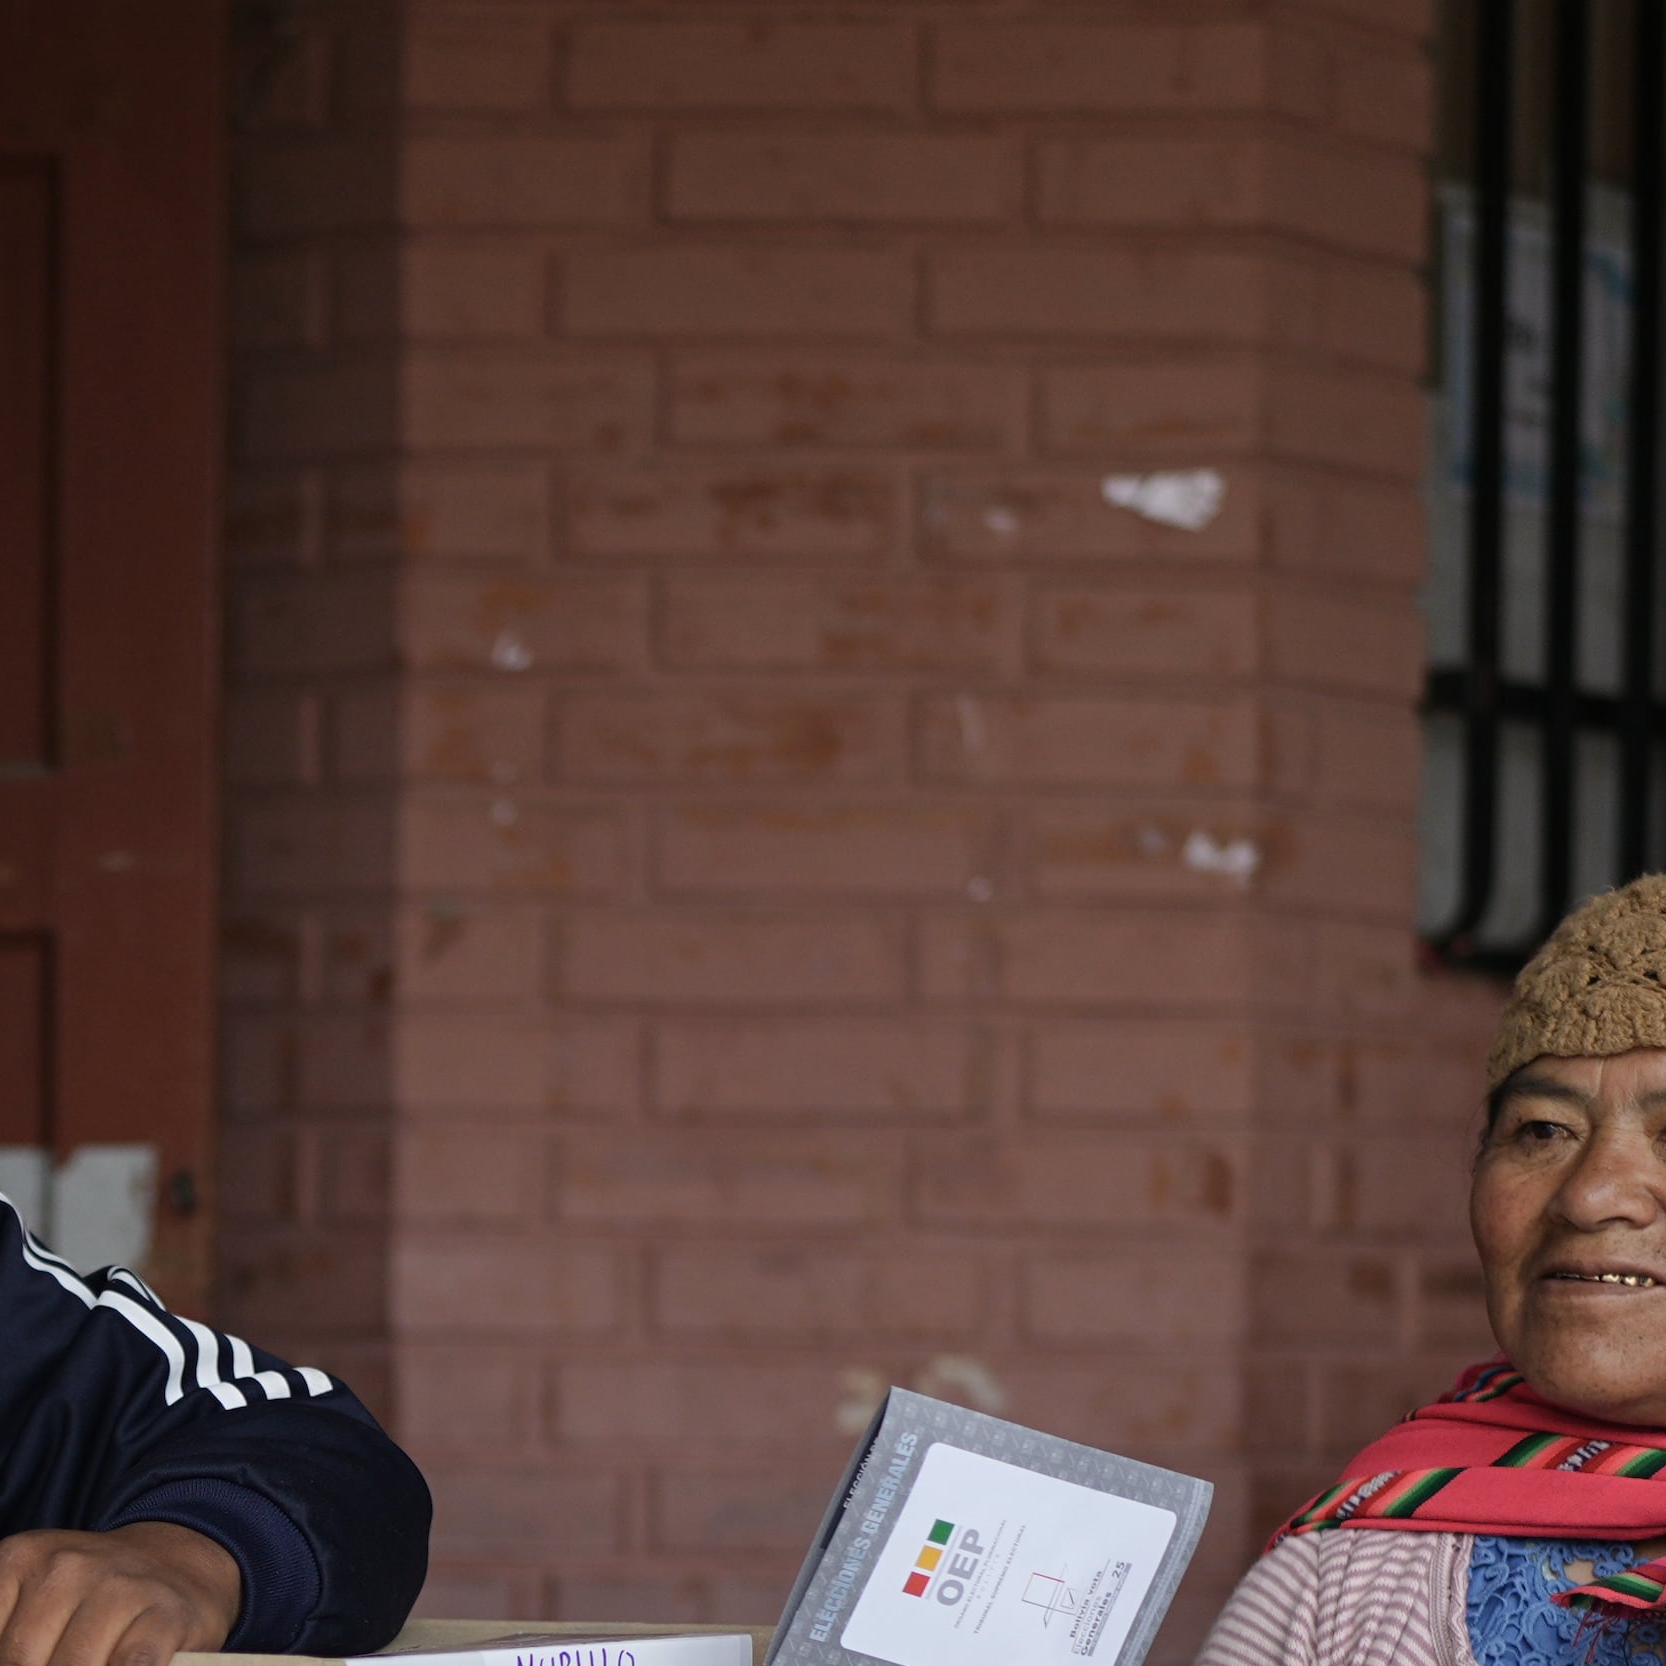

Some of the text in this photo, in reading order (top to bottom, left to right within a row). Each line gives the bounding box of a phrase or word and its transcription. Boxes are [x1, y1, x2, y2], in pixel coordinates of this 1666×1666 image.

[809, 1431, 918, 1643] ELECCIONES GENERALES
[936, 1529, 984, 1606] OEP
[1069, 1570, 1103, 1638] Bolivia vota
[1080, 1591, 1113, 1656] Generales
[1111, 1560, 1126, 1579] 25
